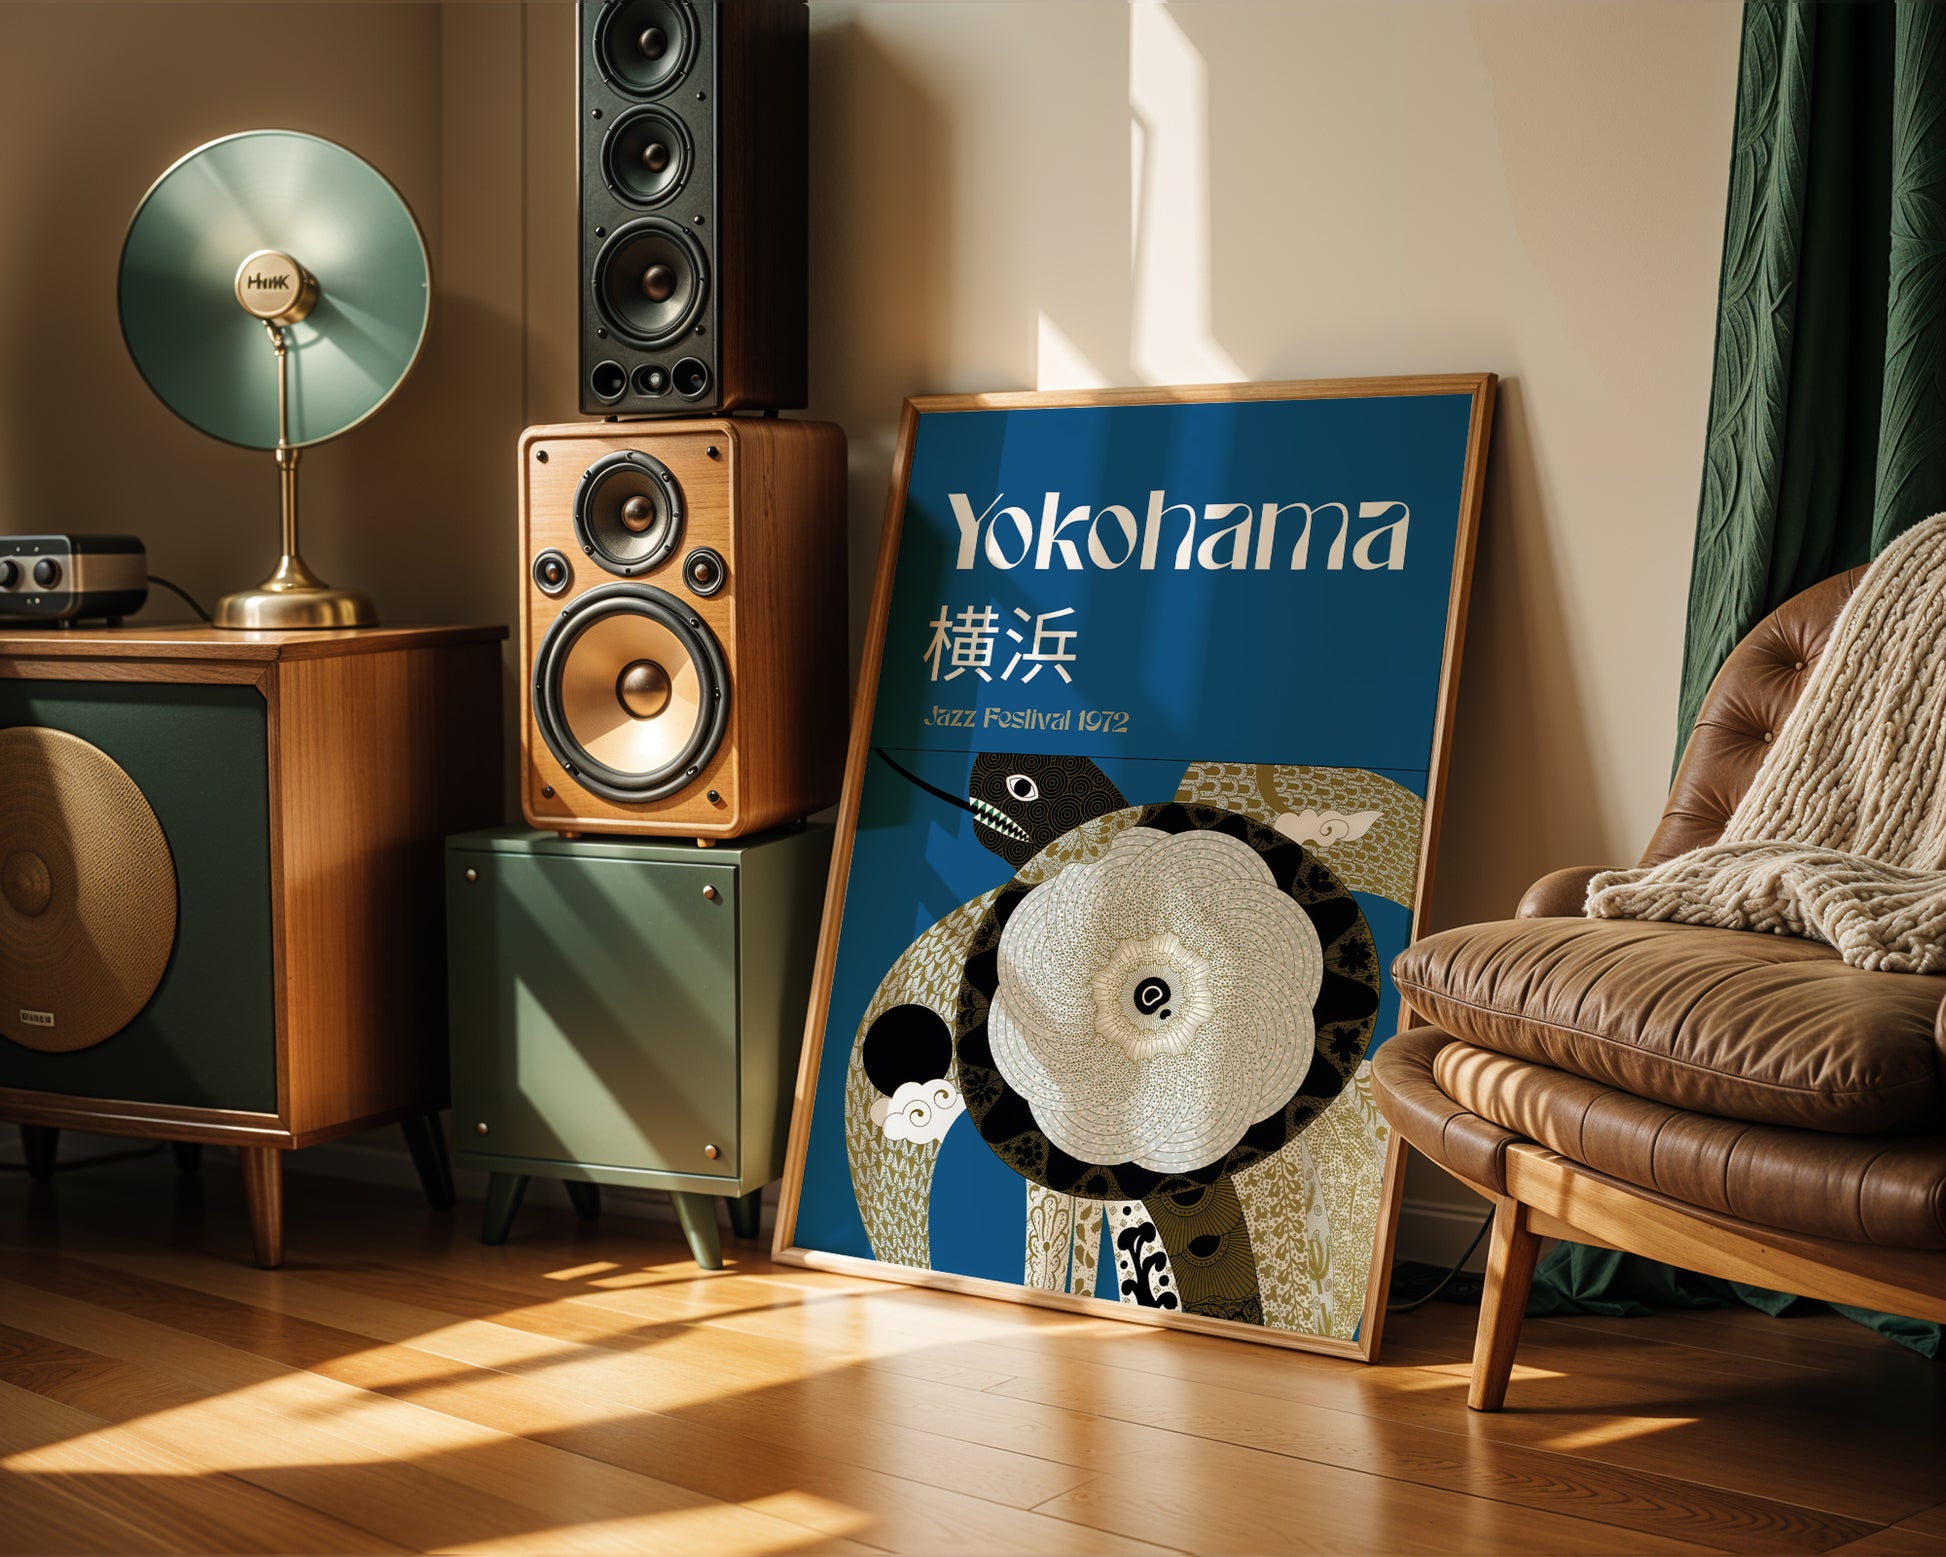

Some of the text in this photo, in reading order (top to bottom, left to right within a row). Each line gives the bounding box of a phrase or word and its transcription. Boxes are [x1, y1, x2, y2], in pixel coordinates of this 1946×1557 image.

[948, 490, 1410, 571] Yokohama
[923, 604, 1078, 684] 横浜
[923, 705, 1130, 733] Jazz Festival 1972
